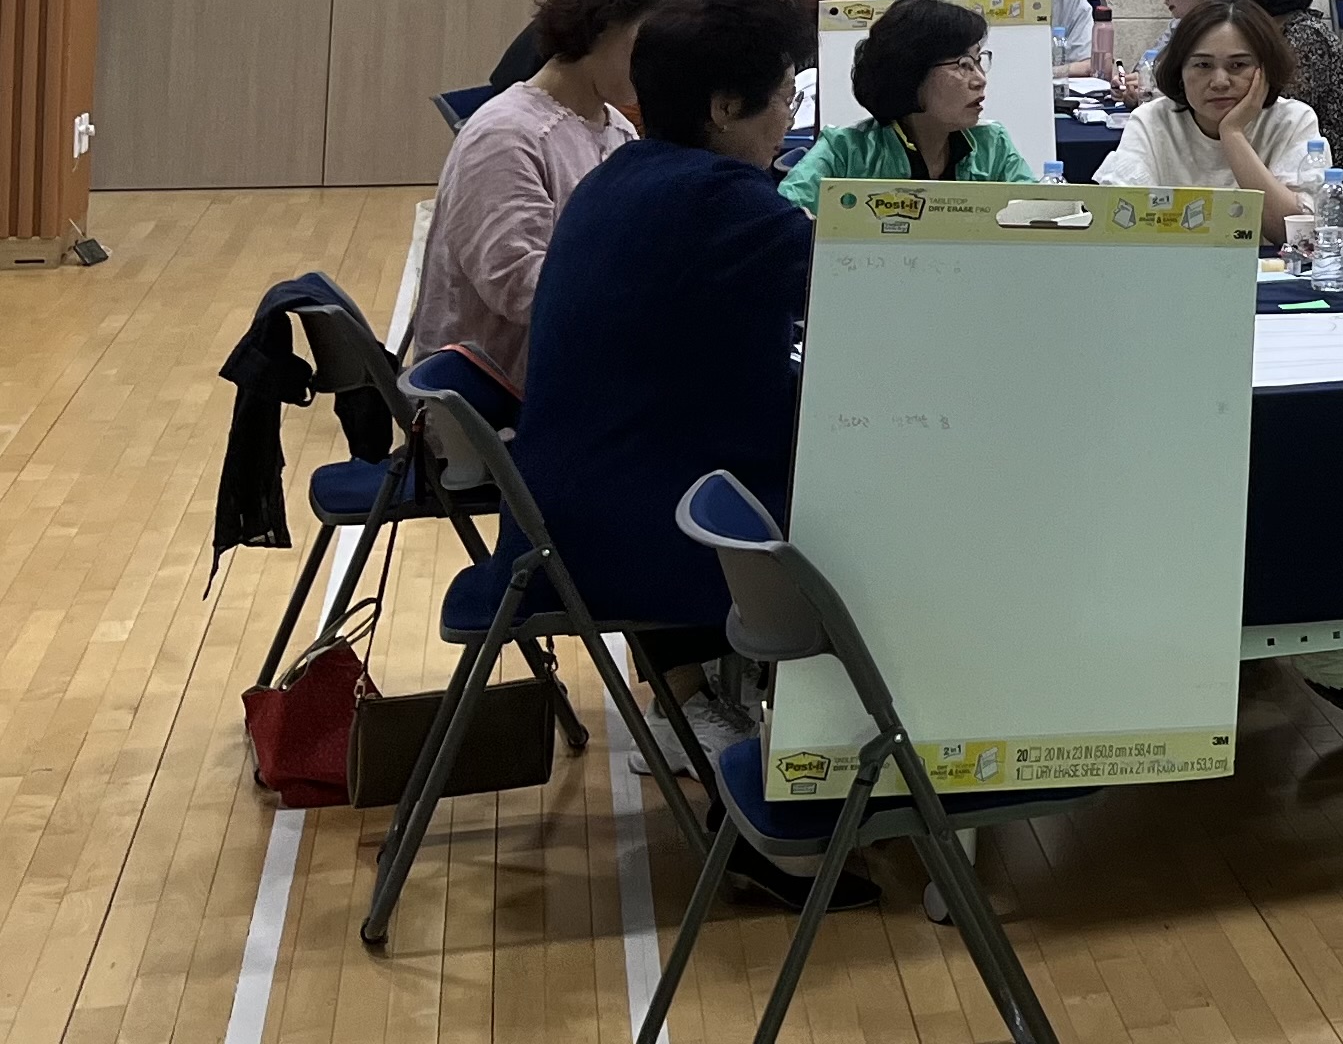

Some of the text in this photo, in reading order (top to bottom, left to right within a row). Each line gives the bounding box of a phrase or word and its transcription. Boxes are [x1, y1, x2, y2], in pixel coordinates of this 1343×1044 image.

[875, 198, 920, 210] Post-it
[1233, 229, 1253, 240] 3M
[1212, 736, 1229, 745] 3M
[1016, 749, 1028, 762] 20
[785, 762, 824, 772] Post-it
